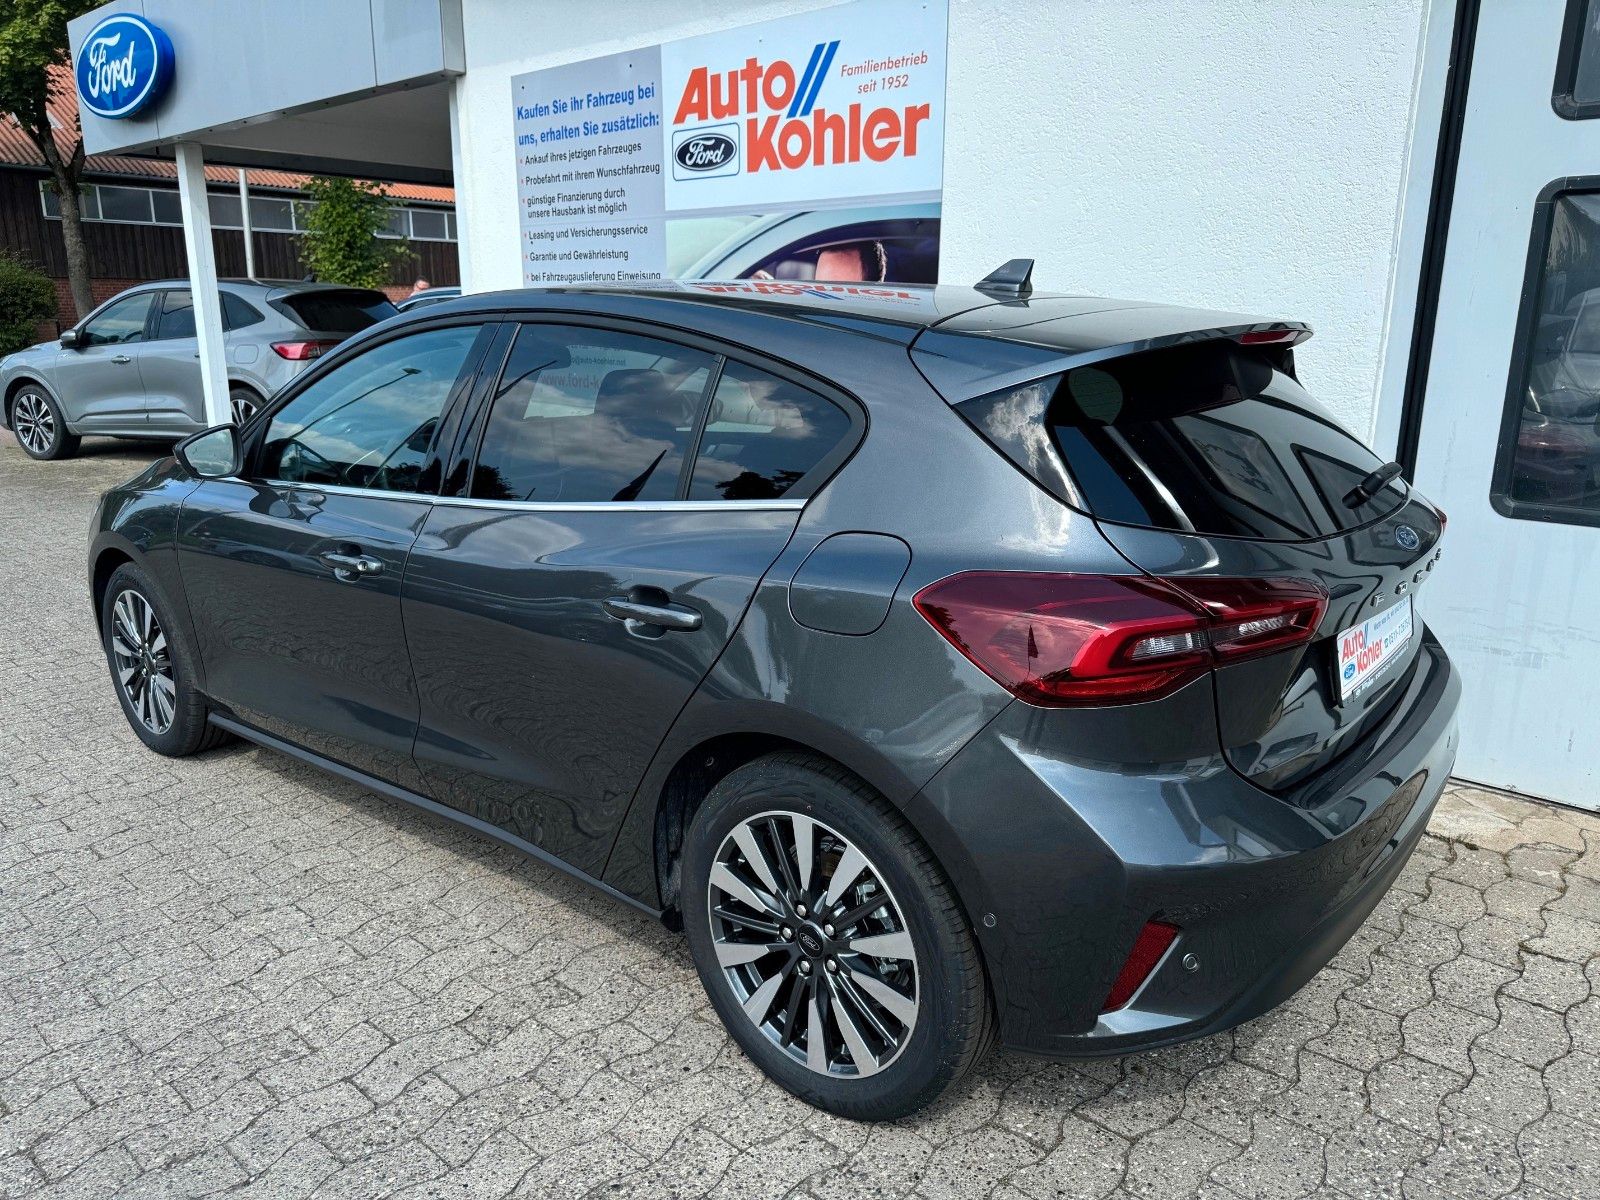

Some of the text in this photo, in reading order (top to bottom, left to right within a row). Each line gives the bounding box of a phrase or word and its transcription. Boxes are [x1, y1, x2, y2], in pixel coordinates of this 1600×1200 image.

[88, 32, 136, 98] Ford
[840, 50, 928, 77] Familienbetrieb
[673, 57, 796, 125] Auto
[857, 74, 909, 94] seit 1952
[517, 82, 655, 120] Kaufen Sie ihr Fahrzeug bei
[518, 111, 660, 147] uns, erhalten Sie zusätzlich:
[525, 142, 642, 166] Ankauf ihres jetzigen Fahrzeuges
[685, 136, 725, 166] Ford
[525, 163, 660, 186] Probefahrt mit ihrem Wunschfahrzeug
[527, 187, 626, 207] günstige Finanzierung durch
[527, 201, 627, 219] unsere Hausbank ist möglich
[528, 224, 648, 241] Leasing und Versicherungsservice
[530, 248, 629, 262] Garantie und Gewährleistung
[530, 272, 541, 282] bei
[542, 270, 616, 284] Fahrzeugauslieferung
[1342, 630, 1364, 663] Auto
